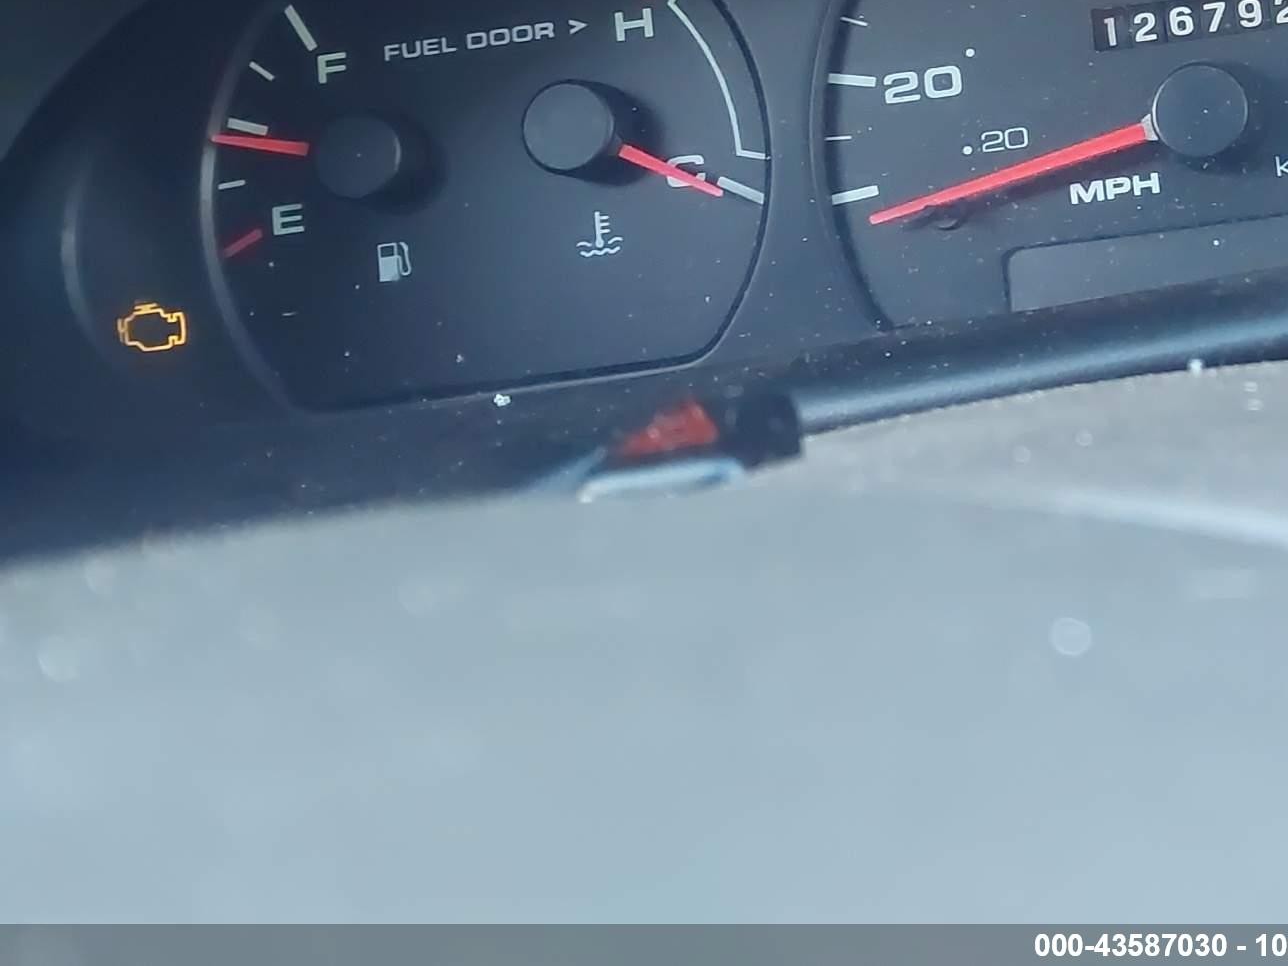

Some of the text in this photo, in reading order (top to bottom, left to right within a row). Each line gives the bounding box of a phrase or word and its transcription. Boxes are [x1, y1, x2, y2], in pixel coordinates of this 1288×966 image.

[384, 21, 555, 61] FUEL DOOR
[614, 8, 654, 41] H
[317, 52, 347, 84] F
[883, 65, 963, 104] 20
[980, 127, 1029, 152] 20
[666, 155, 706, 188] C
[1070, 172, 1161, 205] MPH
[272, 204, 304, 235] E
